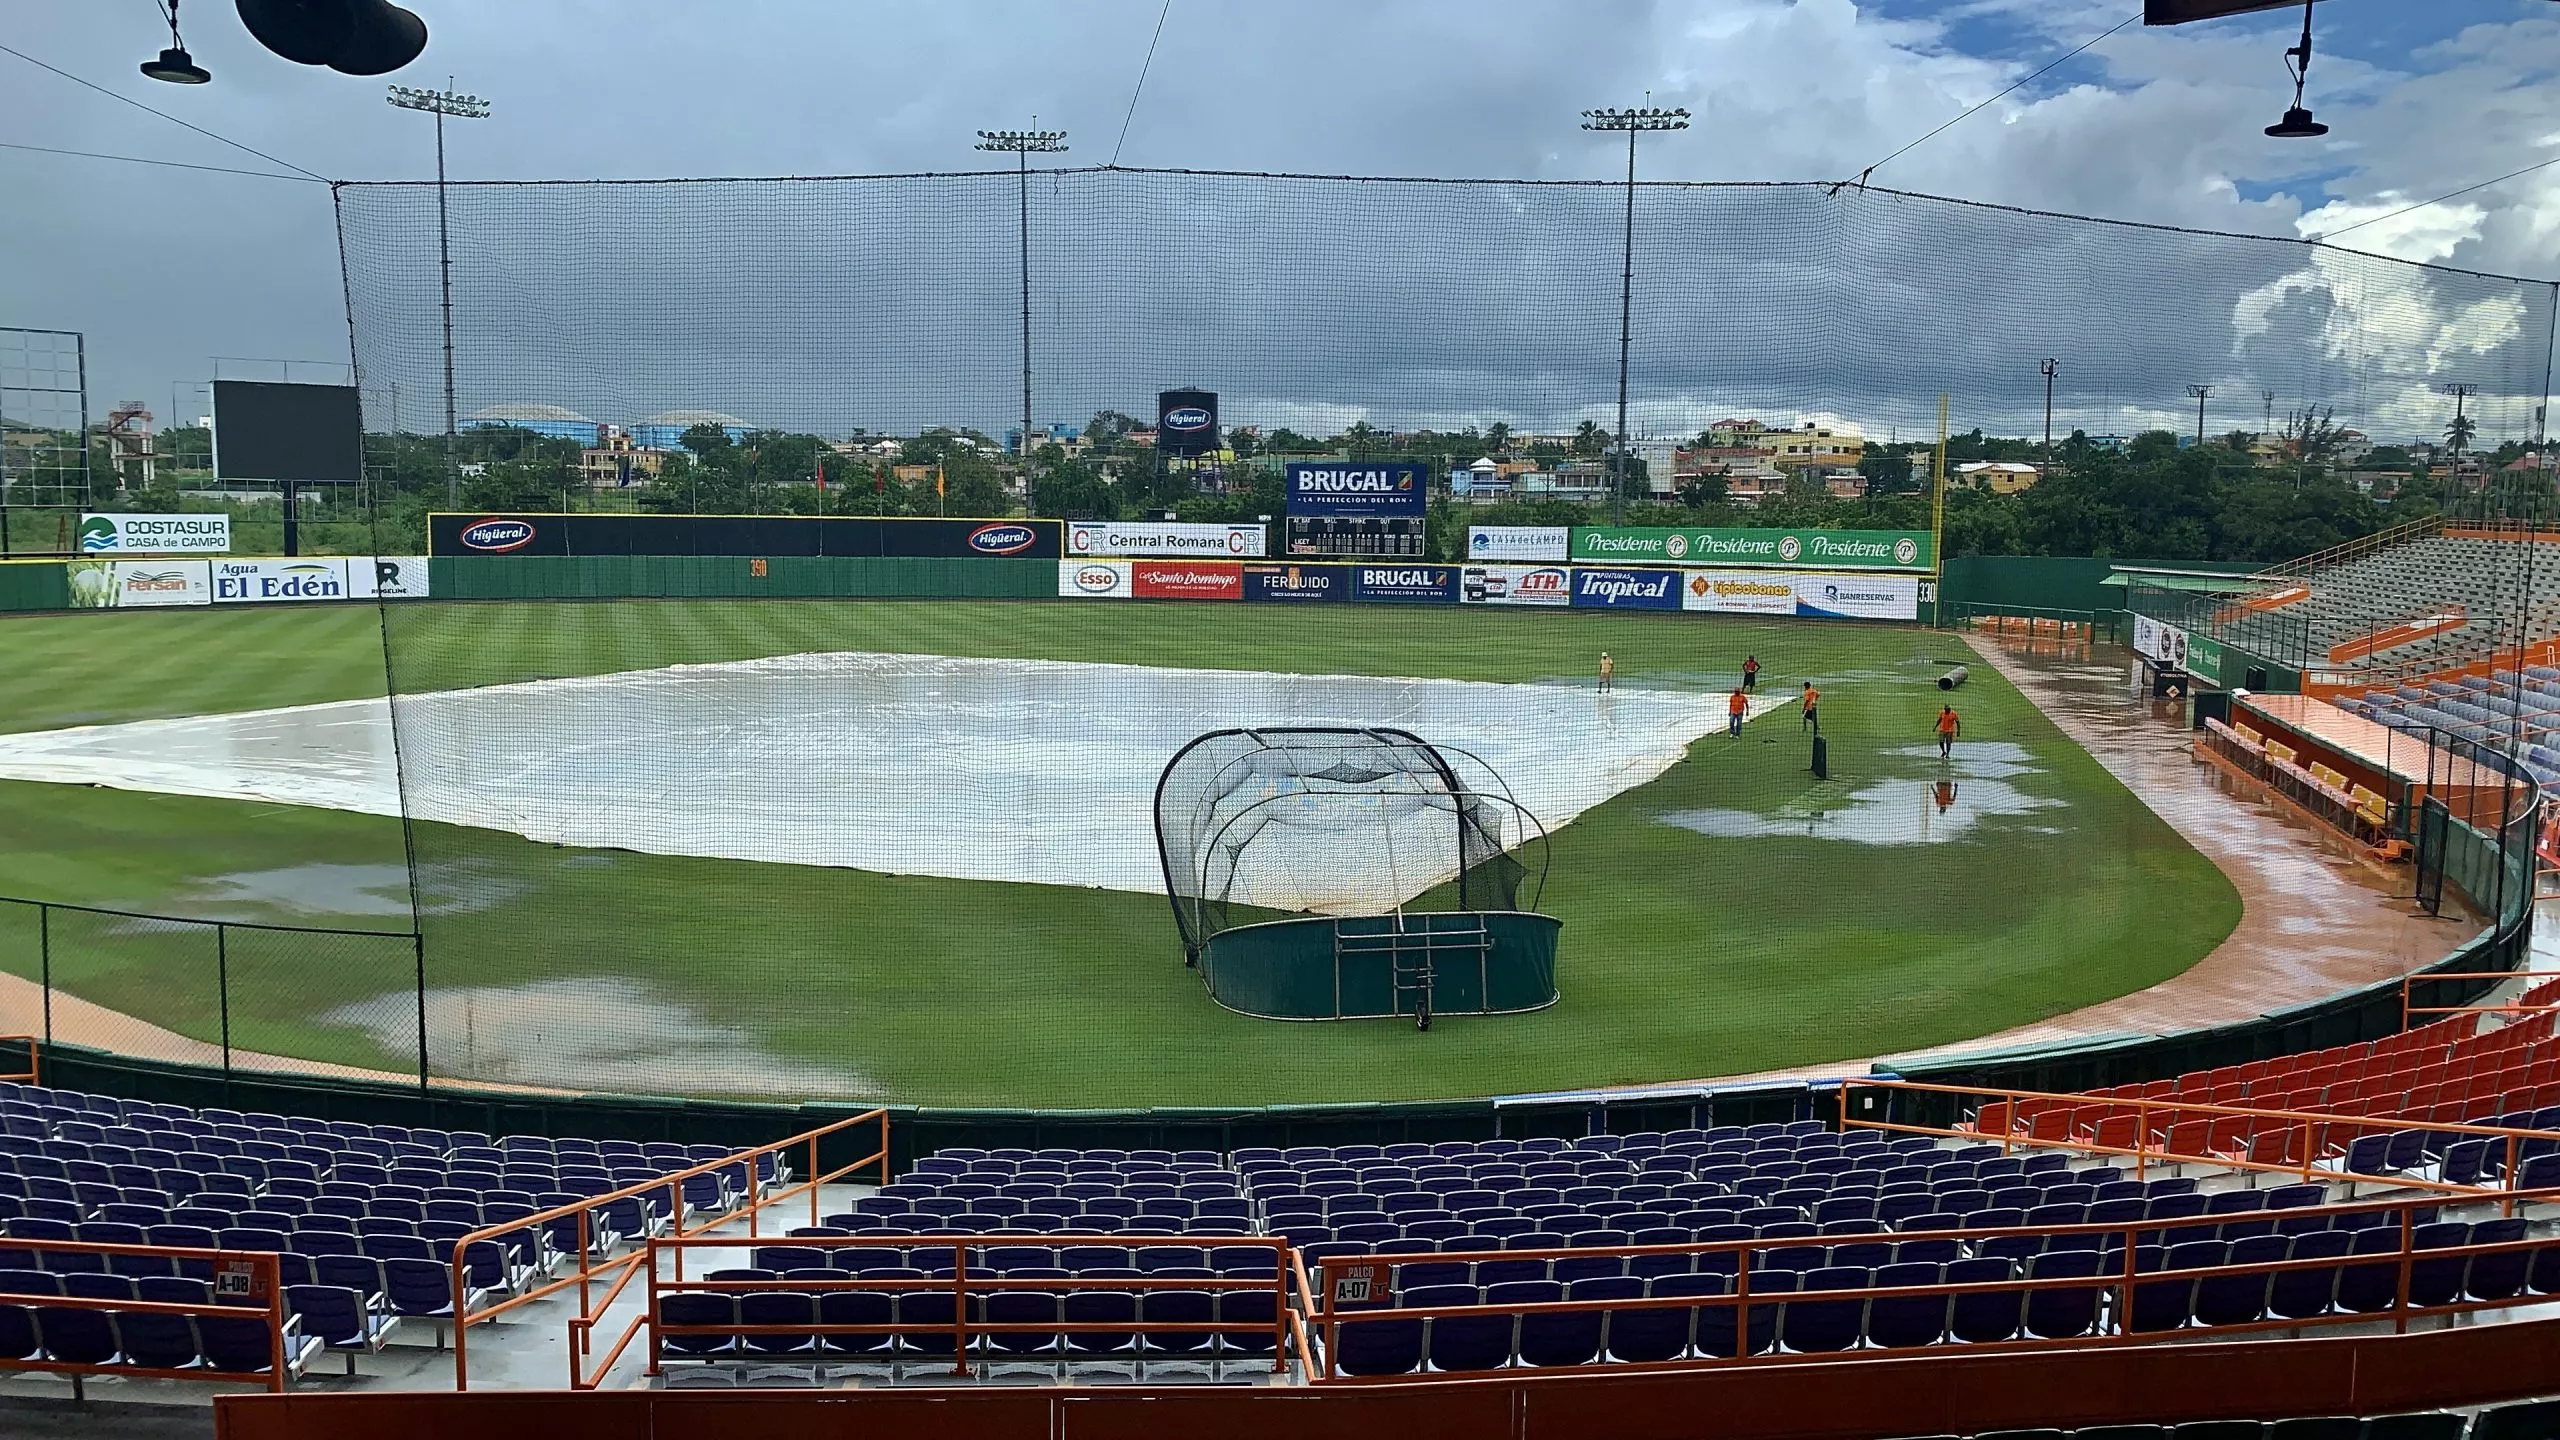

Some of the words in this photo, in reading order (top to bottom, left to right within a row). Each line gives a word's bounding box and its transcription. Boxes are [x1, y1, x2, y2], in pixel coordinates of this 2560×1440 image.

[1298, 470, 1394, 491] BRUGAL
[125, 521, 225, 535] COSTASUR
[126, 537, 160, 548] CASA
[163, 537, 178, 547] de
[181, 537, 226, 547] CAMPO
[1109, 534, 1160, 547] Central
[1166, 535, 1225, 548] Romana
[1491, 534, 1516, 545] CASA
[1518, 535, 1529, 544] de
[1530, 535, 1565, 546] CAMPO
[1585, 533, 1663, 552] Presidente
[1695, 535, 1775, 554] Presidente
[1810, 536, 1891, 557] Presidente
[220, 563, 258, 576] Agua
[750, 559, 767, 577] 390
[1149, 571, 1185, 585] Santo
[1184, 571, 1237, 589] Domingo
[1263, 575, 1330, 589] FERQUIDO
[1363, 569, 1433, 586] BRUGAL
[1521, 574, 1560, 589] LTH
[1599, 572, 1631, 580] PINTURAS
[217, 577, 249, 598] El
[260, 574, 341, 598] Edén
[1580, 571, 1670, 604] Tropical
[1919, 582, 1936, 603] 330
[1839, 592, 1895, 602] BANRESERVAS
[1348, 1266, 1375, 1278] PALCO
[219, 1274, 249, 1293] A-08
[1338, 1282, 1367, 1298] A-07
